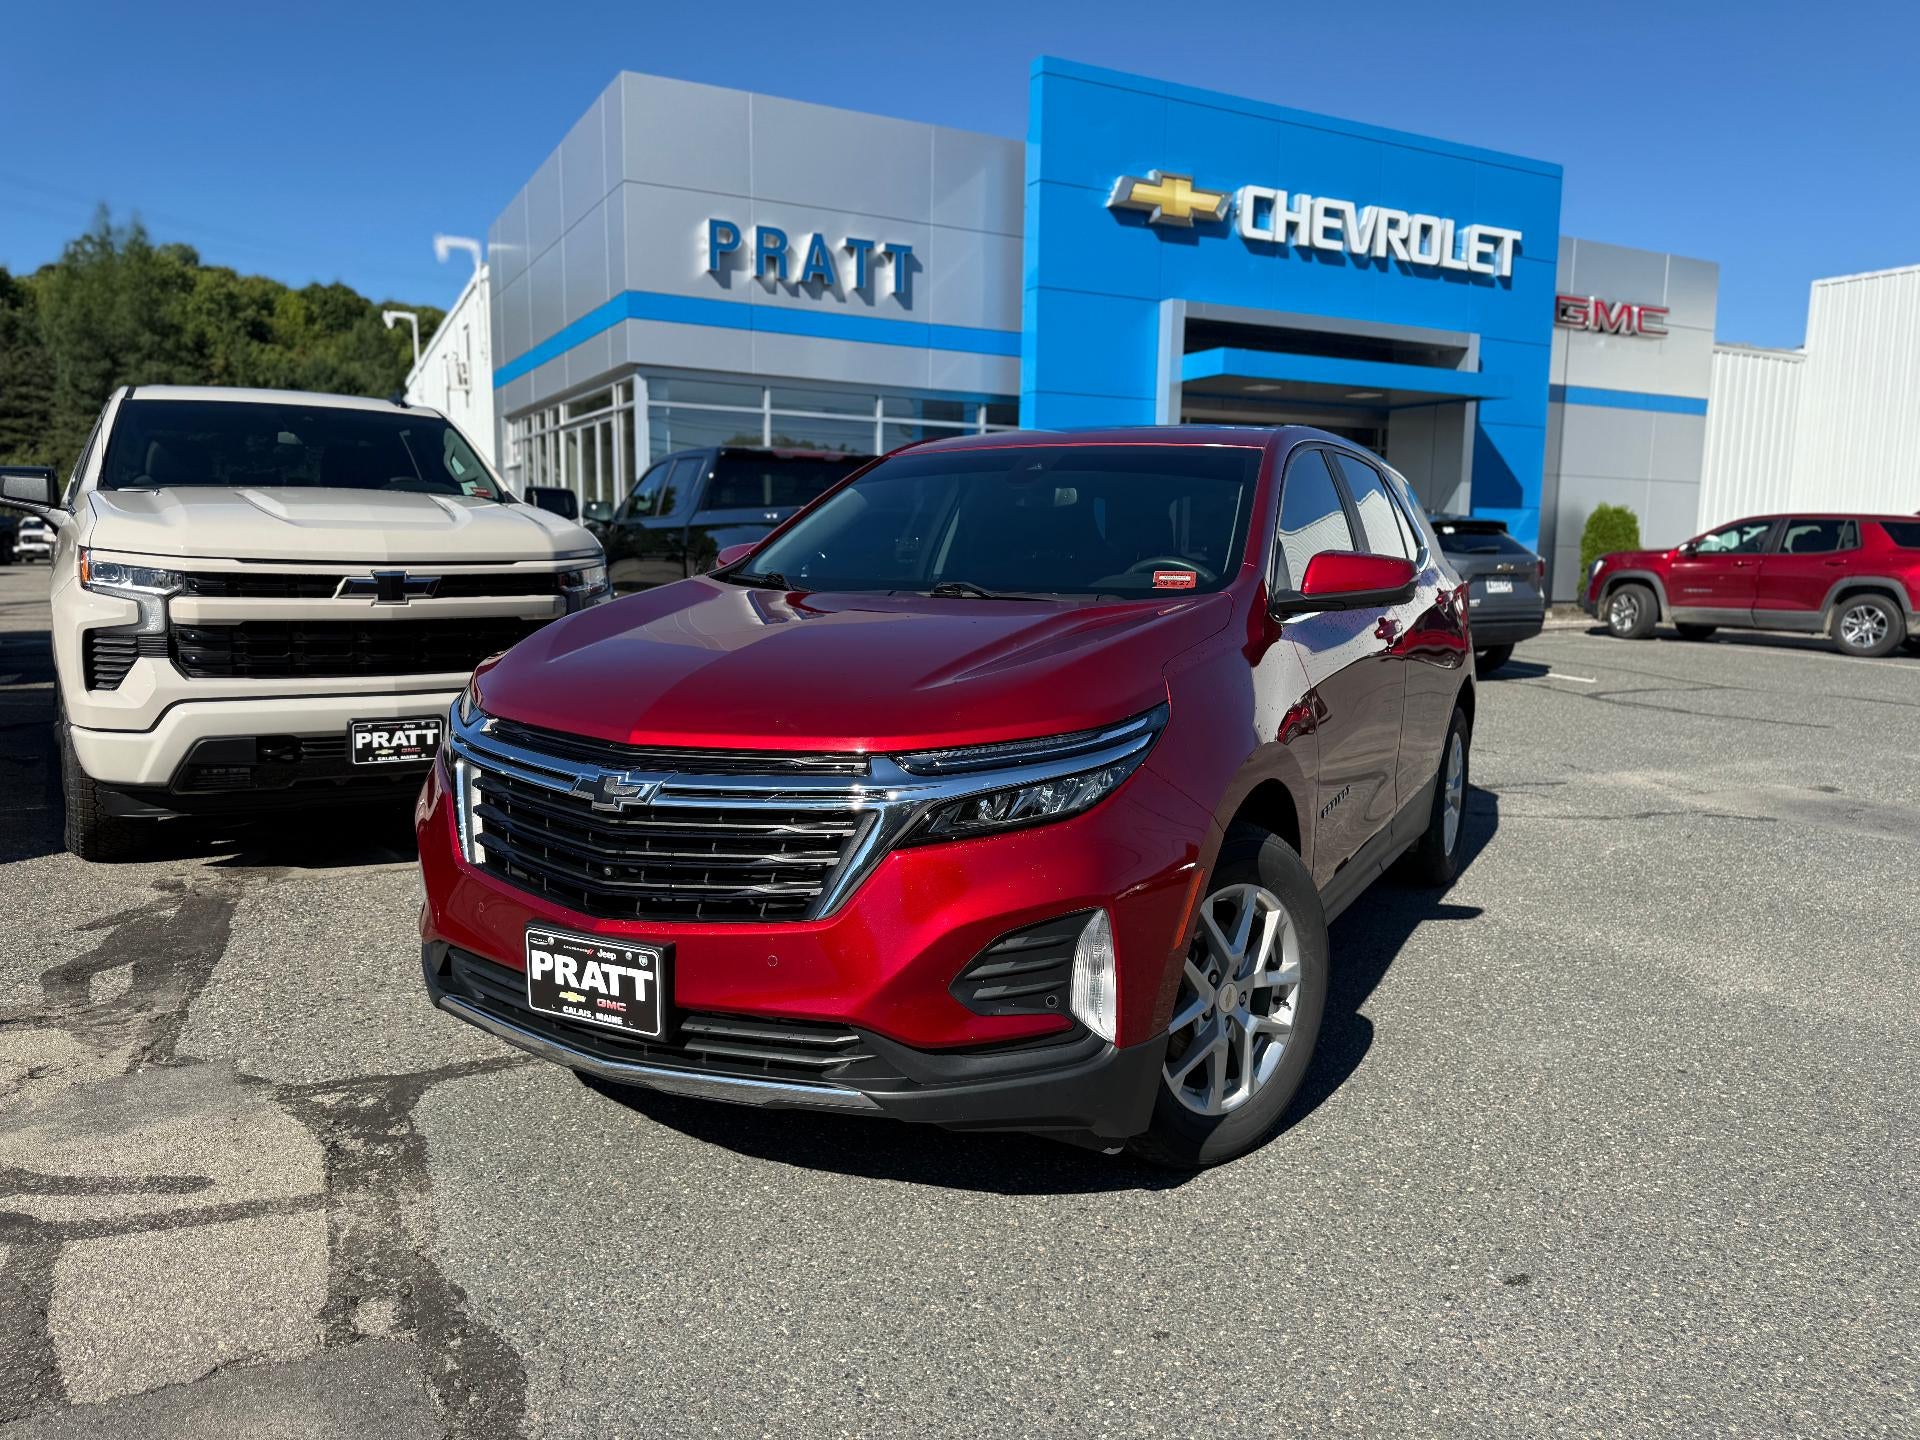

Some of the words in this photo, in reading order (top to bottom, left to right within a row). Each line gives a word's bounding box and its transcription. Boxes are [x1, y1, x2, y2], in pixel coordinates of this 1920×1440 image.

[1235, 184, 1522, 277] CHEVROLET
[704, 217, 914, 294] PRATT
[1555, 295, 1670, 337] GMC
[355, 729, 439, 749] PRATT
[597, 948, 617, 961] Jeep
[531, 949, 654, 1002] PRATT
[562, 1005, 595, 1020] CALAIS,
[595, 1012, 624, 1025] MAINE
[596, 998, 627, 1012] GMC
